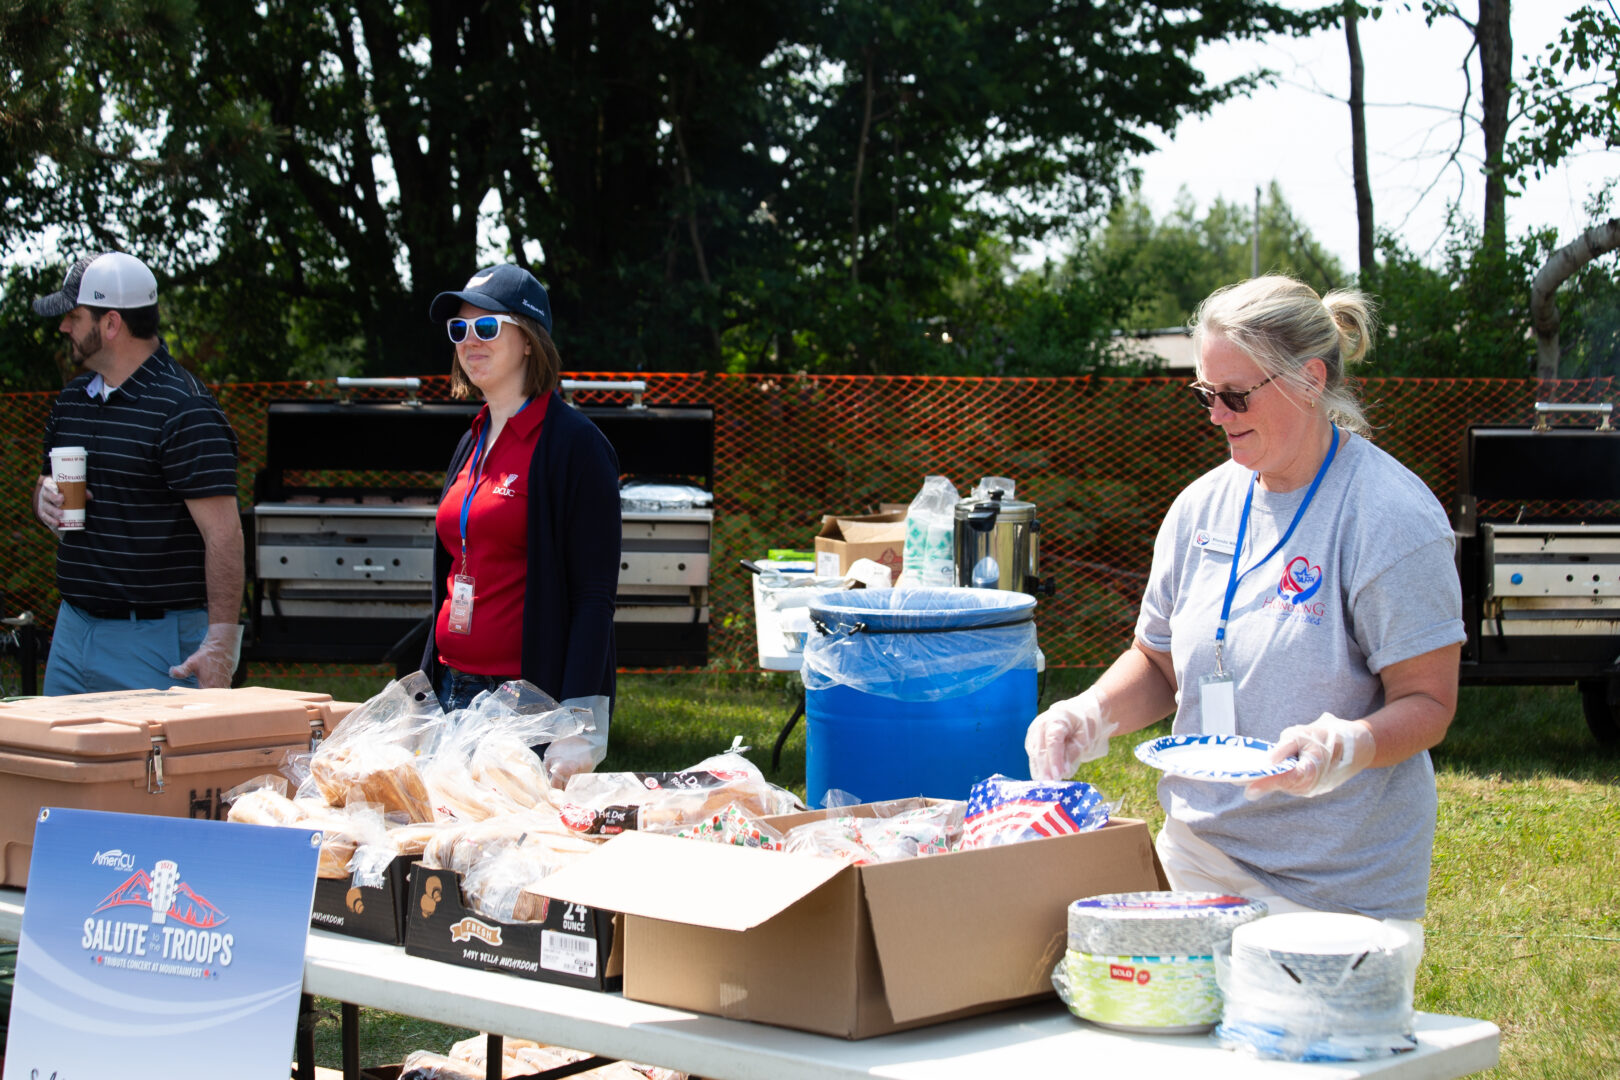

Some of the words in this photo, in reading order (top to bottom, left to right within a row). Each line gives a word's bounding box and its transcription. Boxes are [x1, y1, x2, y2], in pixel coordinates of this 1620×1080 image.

[492, 486, 516, 497] DCUC
[611, 810, 626, 822] Dog
[92, 849, 135, 868] AmeriCU
[563, 901, 588, 922] 24
[466, 921, 492, 941] FRESH
[563, 920, 586, 932] OUNCE
[81, 917, 149, 956] SALUTE
[152, 933, 160, 942] to
[162, 926, 234, 967] TROOPS
[104, 956, 127, 969] TRIBUTE
[127, 959, 151, 972] CONCERT
[150, 963, 159, 972] AT
[159, 963, 203, 978] MOUNTAINFEST
[462, 949, 479, 961] BABY
[480, 952, 499, 966] BELLA
[499, 957, 539, 973] MUSHROOMS
[1111, 967, 1133, 978] SOLO
